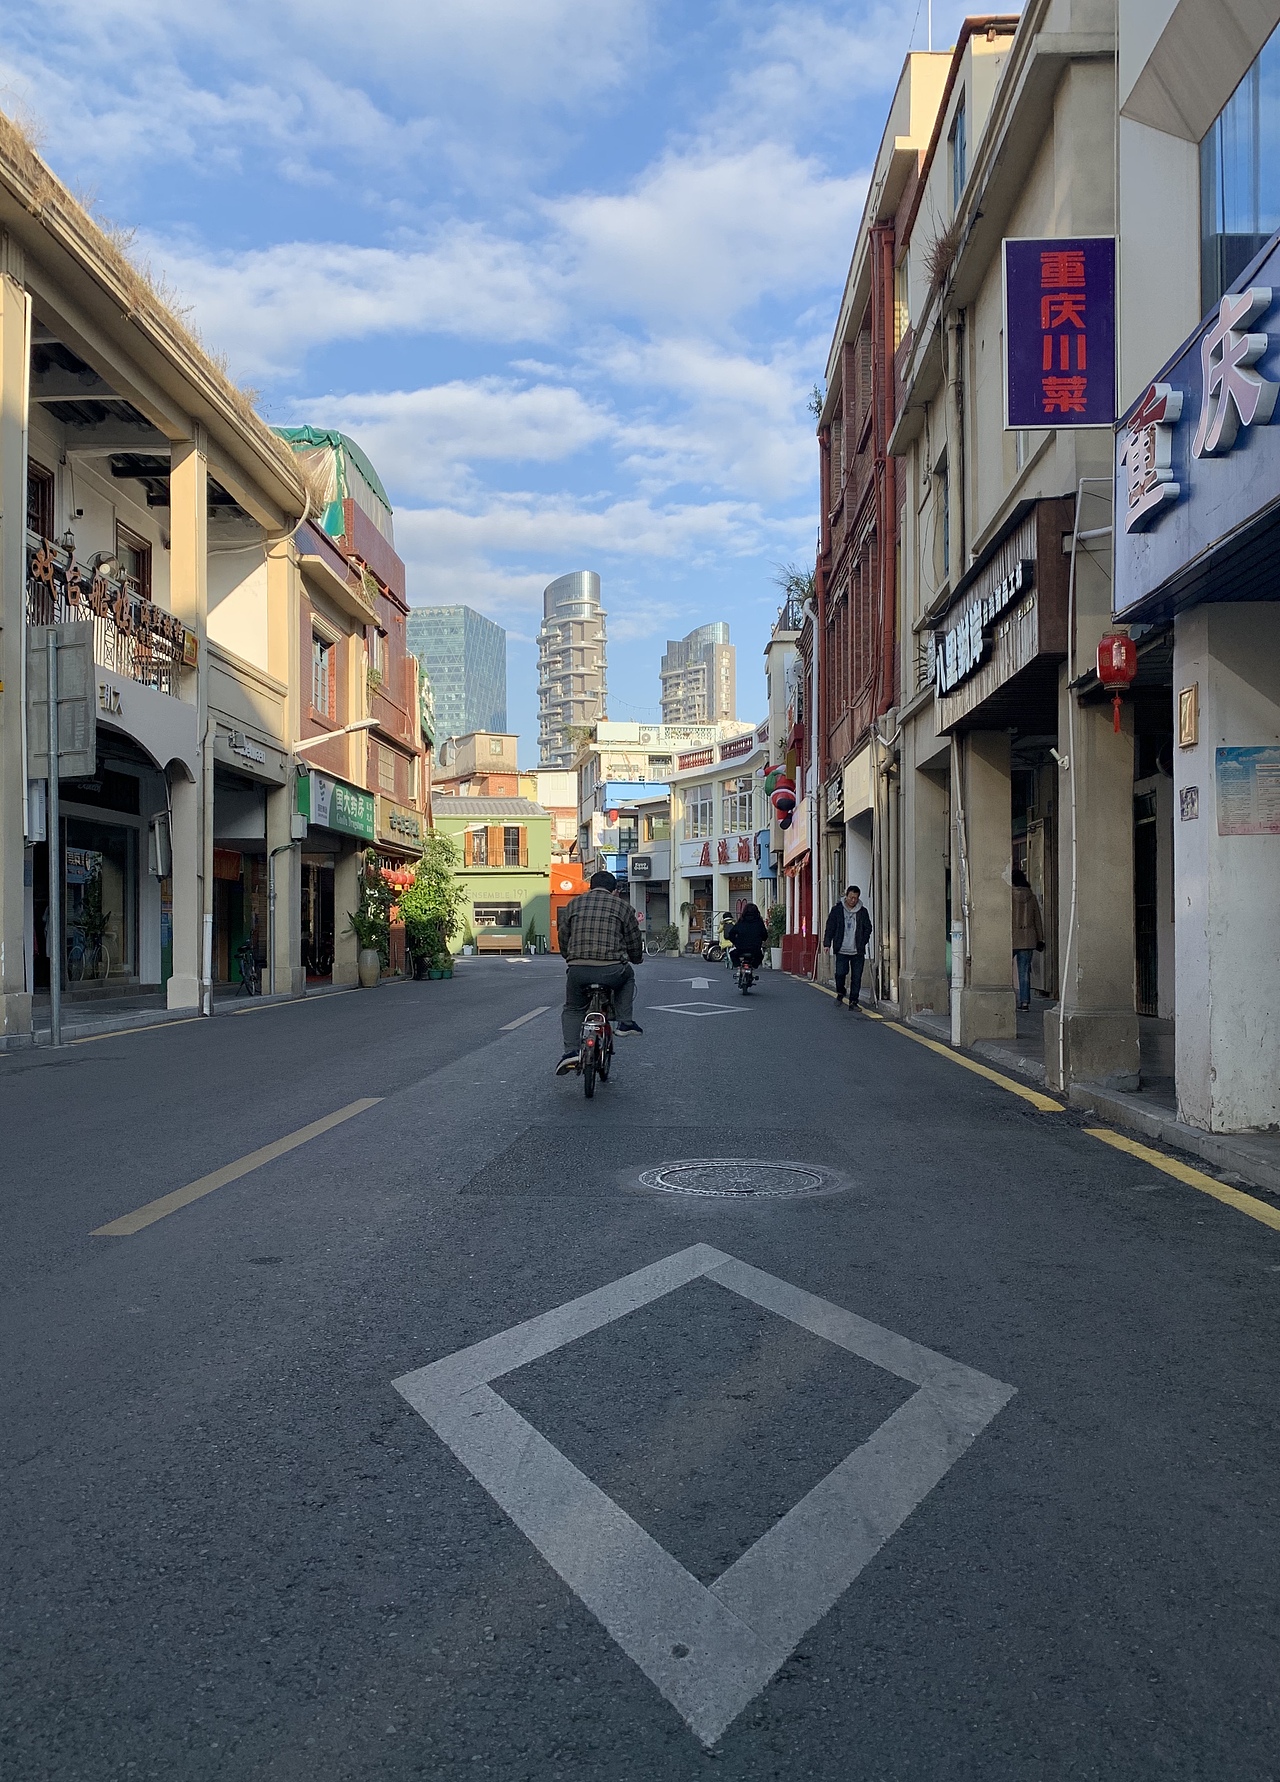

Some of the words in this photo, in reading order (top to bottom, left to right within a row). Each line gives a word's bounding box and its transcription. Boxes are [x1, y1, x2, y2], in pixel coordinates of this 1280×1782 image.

[1040, 250, 1087, 413] 重庆川菜
[1119, 286, 1277, 534] 重庆
[335, 787, 366, 820] 国大药房
[512, 889, 528, 899] 191
